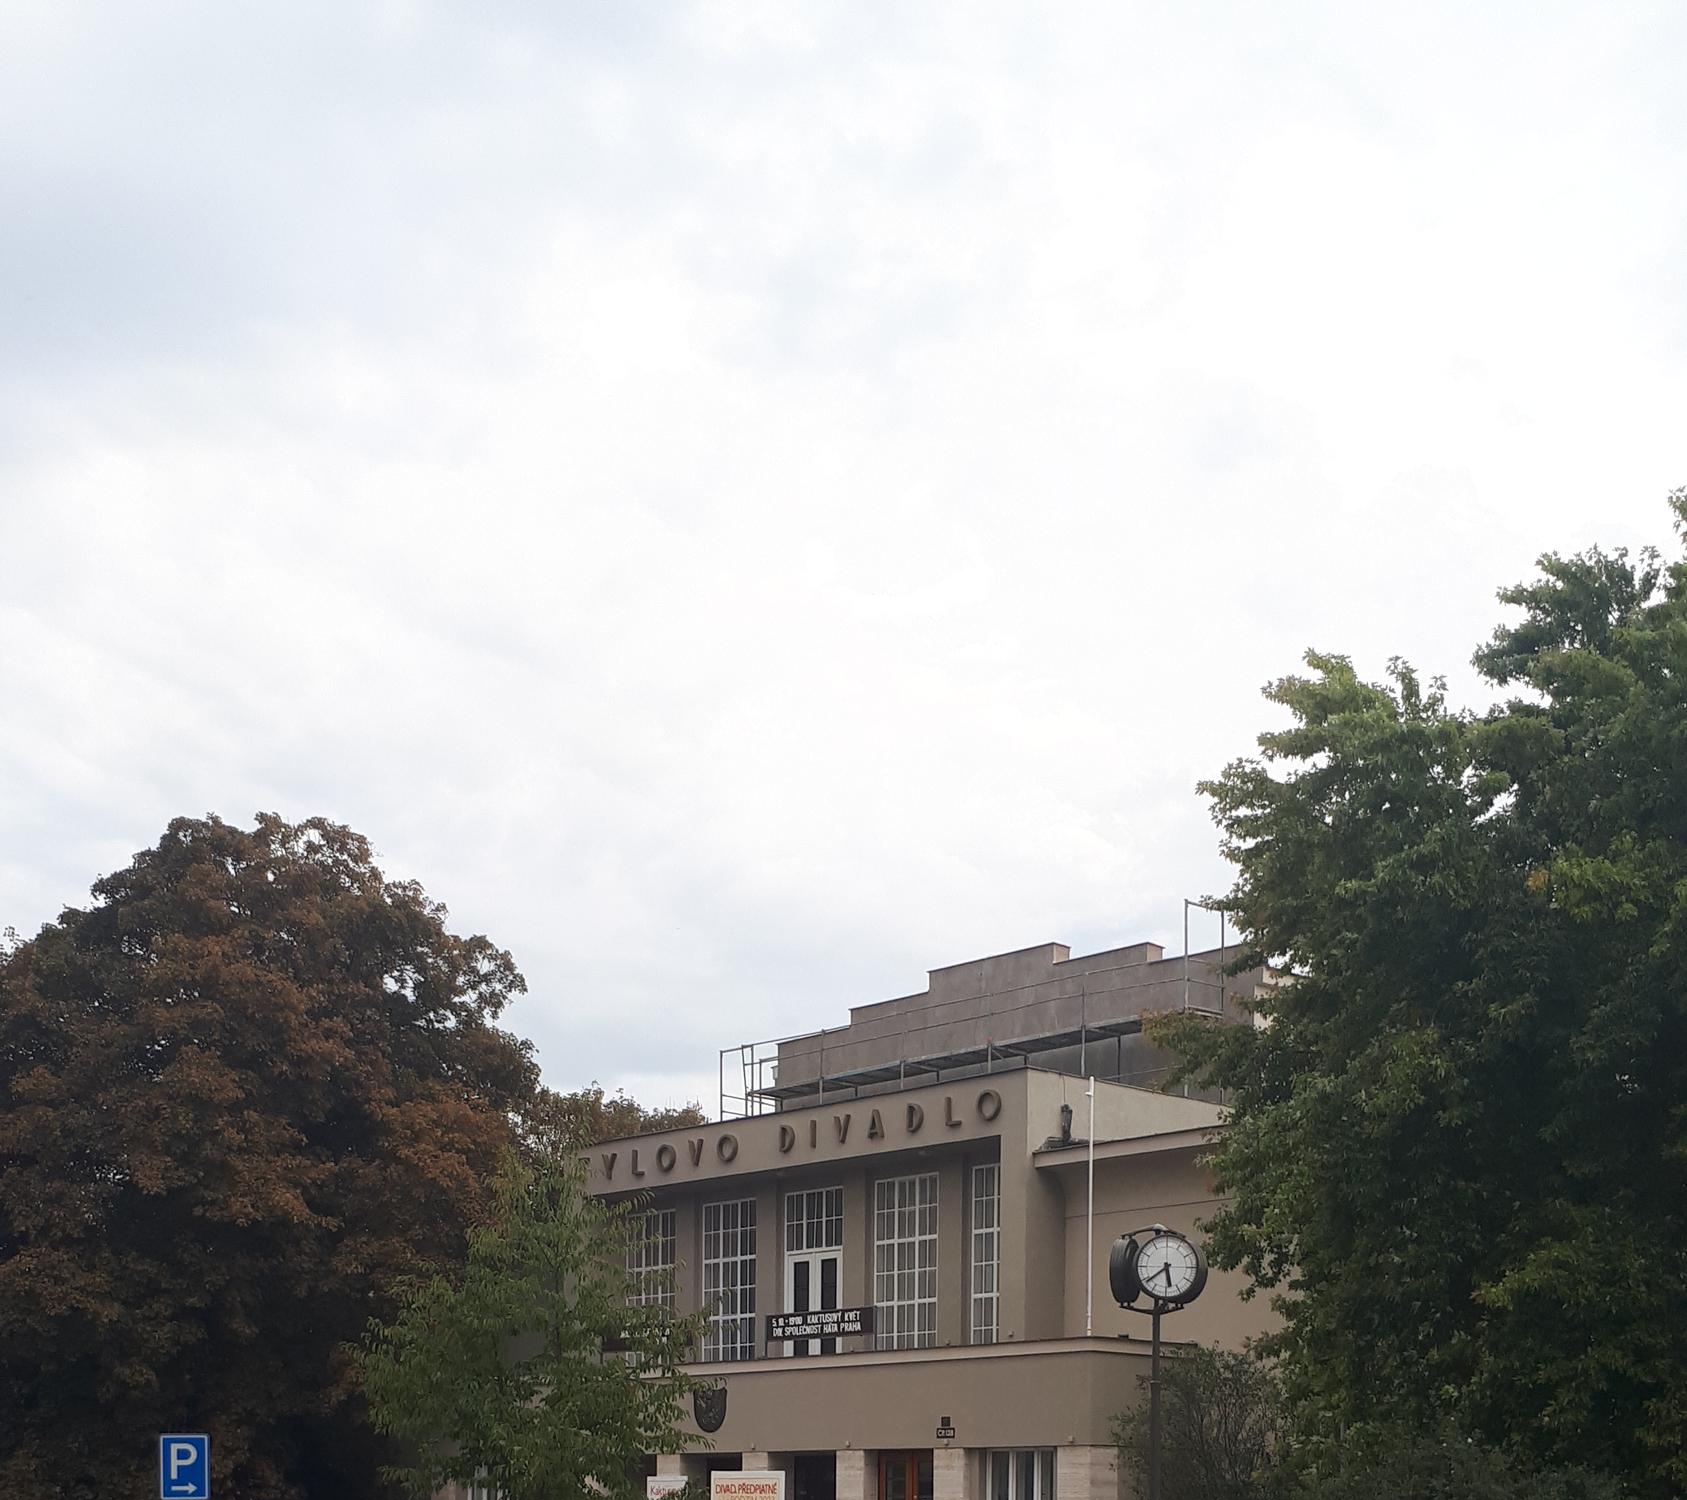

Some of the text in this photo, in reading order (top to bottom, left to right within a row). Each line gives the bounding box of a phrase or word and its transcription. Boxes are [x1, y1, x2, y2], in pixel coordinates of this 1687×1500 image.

[778, 1089, 1002, 1153] DIVADLO
[784, 1324, 822, 1336] SPOLEČNOST
[840, 1321, 862, 1332] PRAHA
[807, 1312, 841, 1324] KAKTUSOVÝ
[170, 1443, 198, 1480] P
